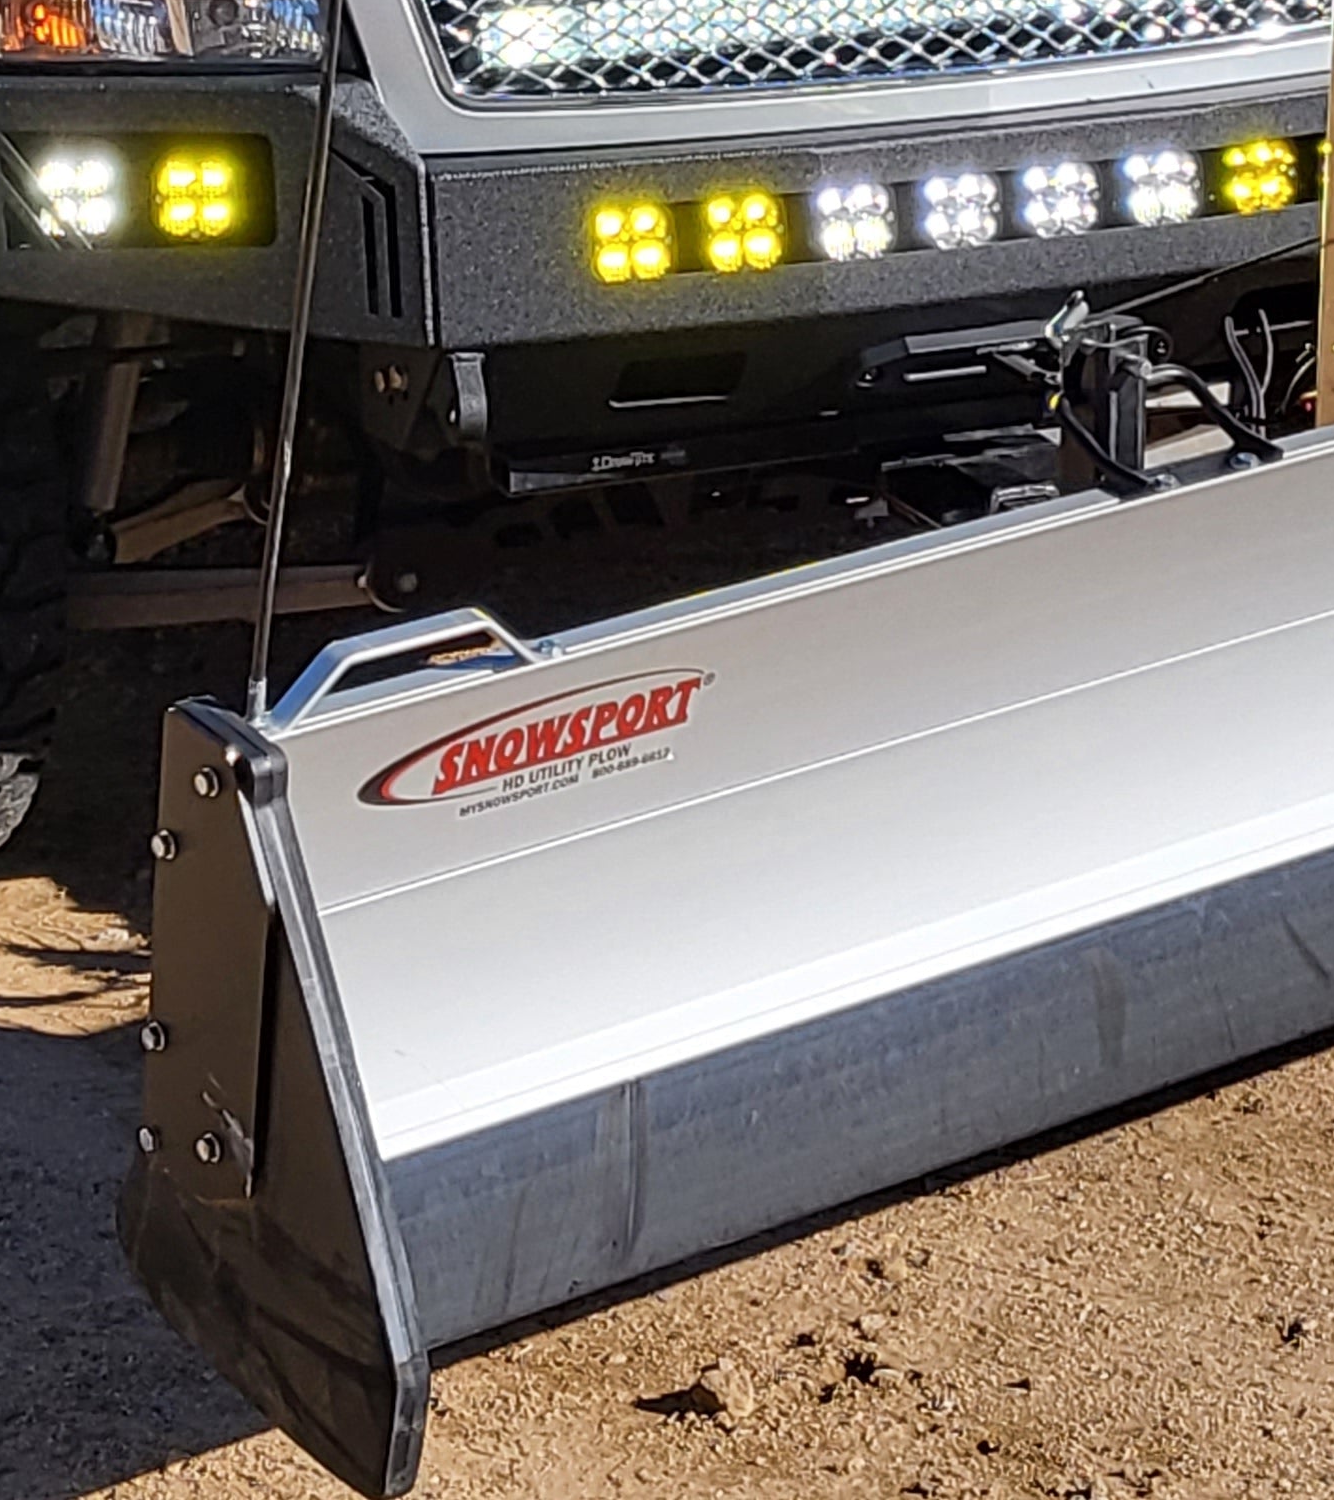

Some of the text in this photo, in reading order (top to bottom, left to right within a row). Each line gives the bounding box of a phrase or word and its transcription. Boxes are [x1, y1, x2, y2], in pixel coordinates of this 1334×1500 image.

[432, 677, 701, 796] SNOWSPORT
[501, 743, 632, 793] HD UTILITY PLOW
